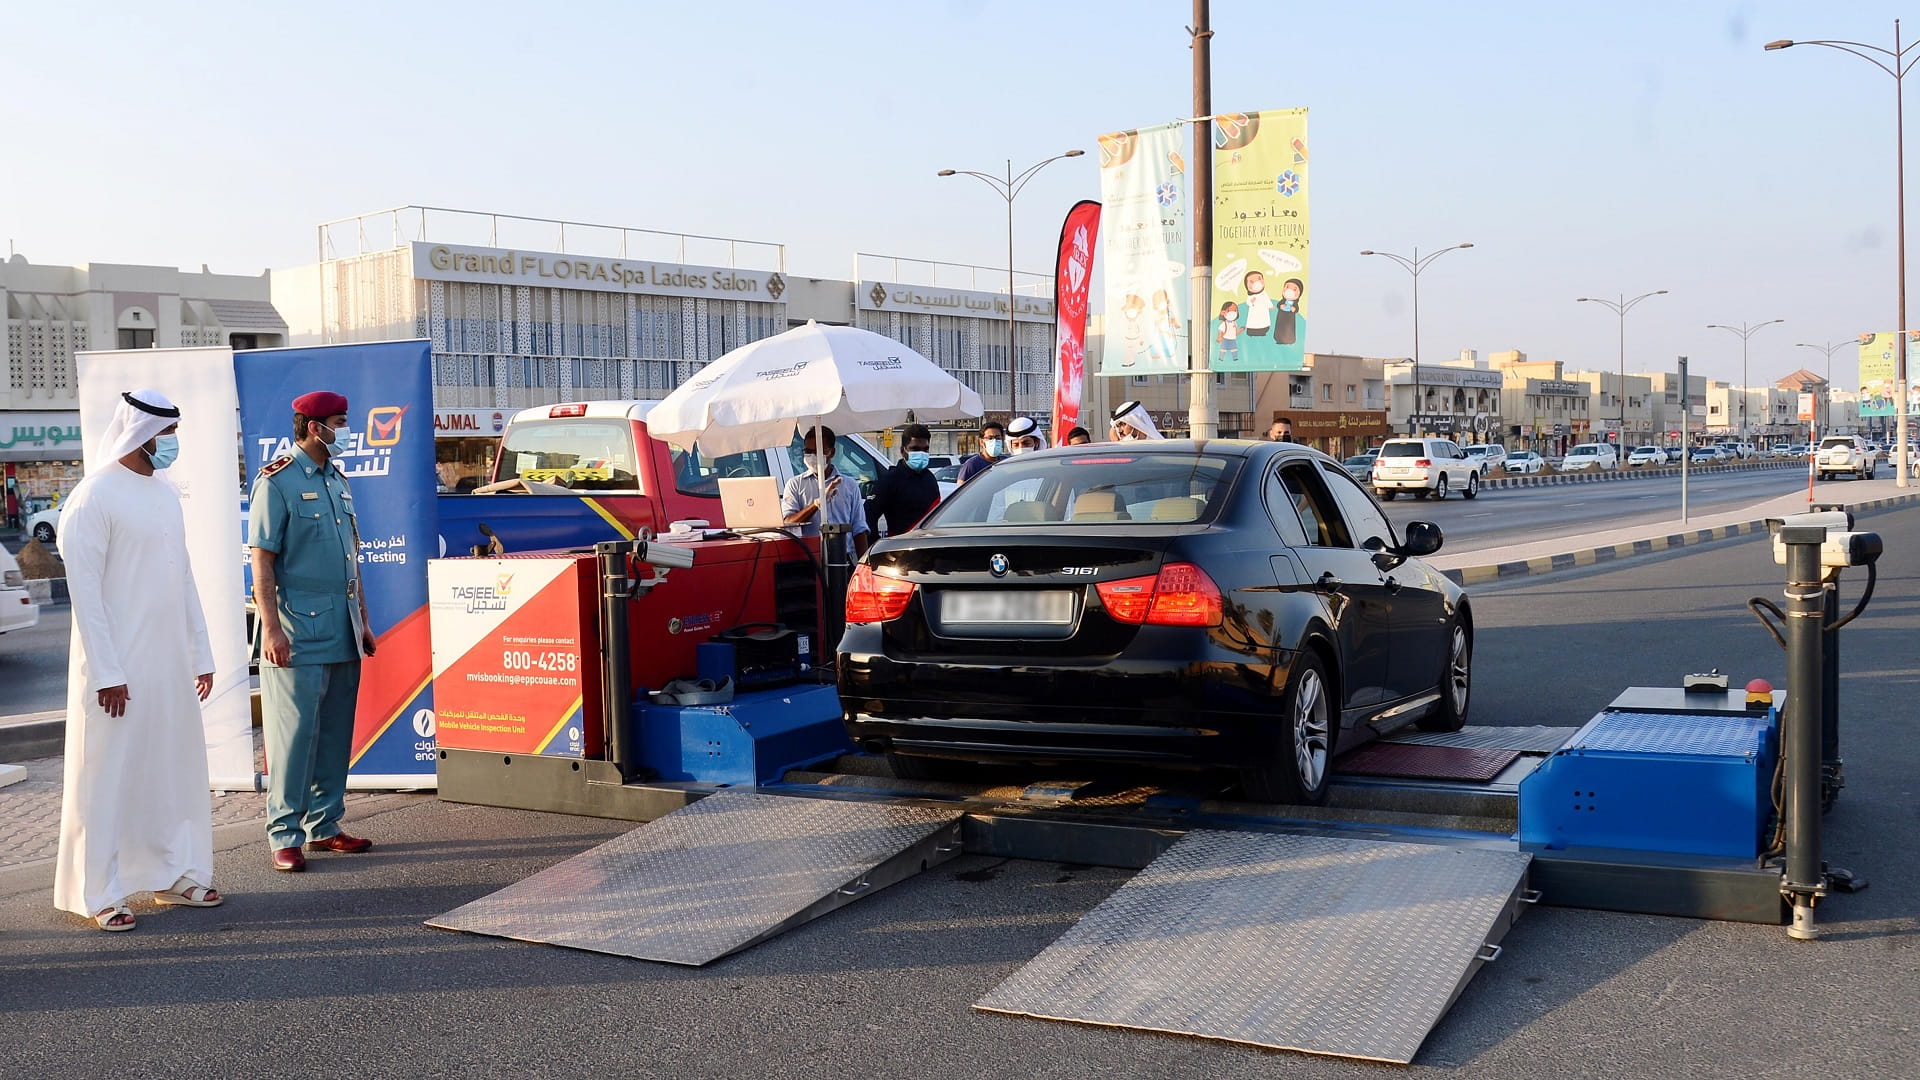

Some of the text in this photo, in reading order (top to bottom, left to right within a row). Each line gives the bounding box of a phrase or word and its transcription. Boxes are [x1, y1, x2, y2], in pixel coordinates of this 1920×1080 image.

[1219, 223, 1305, 239] TOGETHER WE RETURN
[430, 245, 758, 292] Grand FLORA Spa Ladies Salon
[892, 291, 961, 310] للسيدات
[964, 295, 991, 312] سبا
[434, 414, 481, 430] AJMAL
[373, 538, 387, 550] من
[388, 534, 406, 549] أكثر
[365, 551, 406, 565] Testing
[503, 635, 575, 645] For enquiries please contact
[503, 651, 576, 672] 800-4258
[466, 671, 577, 687] mvisbooking@eppcouae.com
[439, 709, 465, 719] للمركبات
[488, 712, 509, 721] الفحص
[509, 714, 526, 723] وحدة
[439, 720, 526, 734] Mobile Vehicle Inspection Unit
[415, 752, 436, 761] eno
